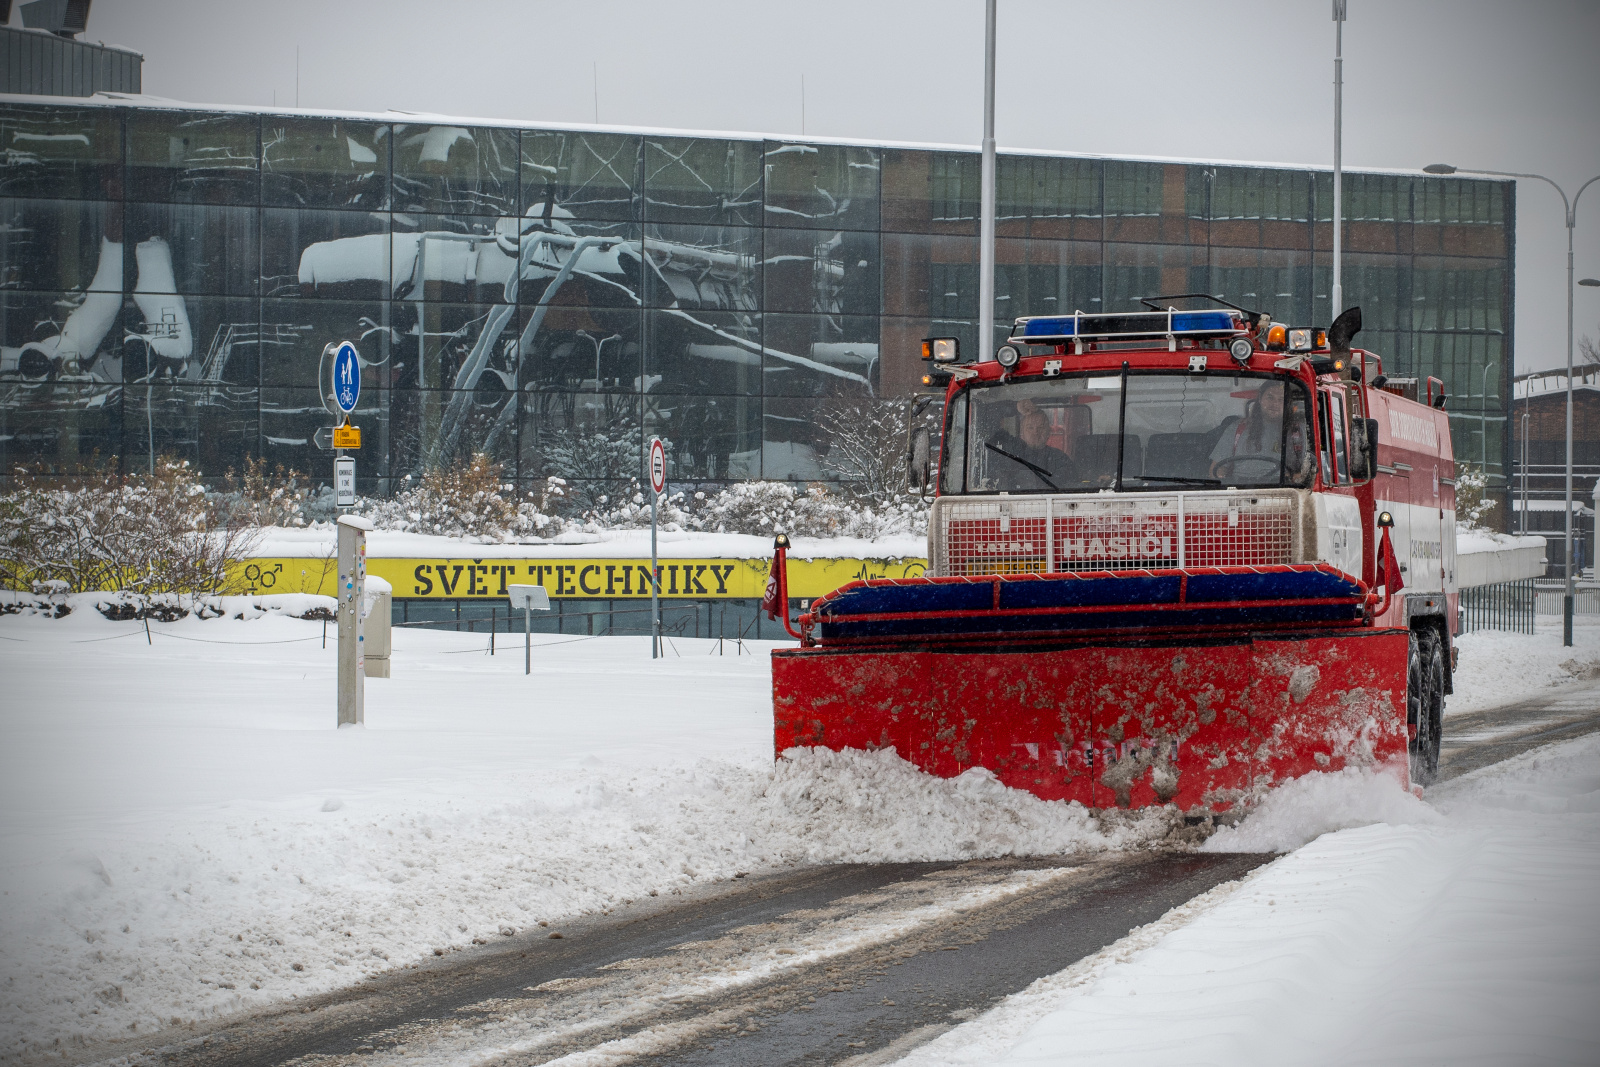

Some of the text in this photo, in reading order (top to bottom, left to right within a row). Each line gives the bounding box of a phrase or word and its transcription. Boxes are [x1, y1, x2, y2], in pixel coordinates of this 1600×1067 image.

[1063, 531, 1172, 558] HASIČI
[413, 558, 735, 596] SVĚT TECHNIKY
